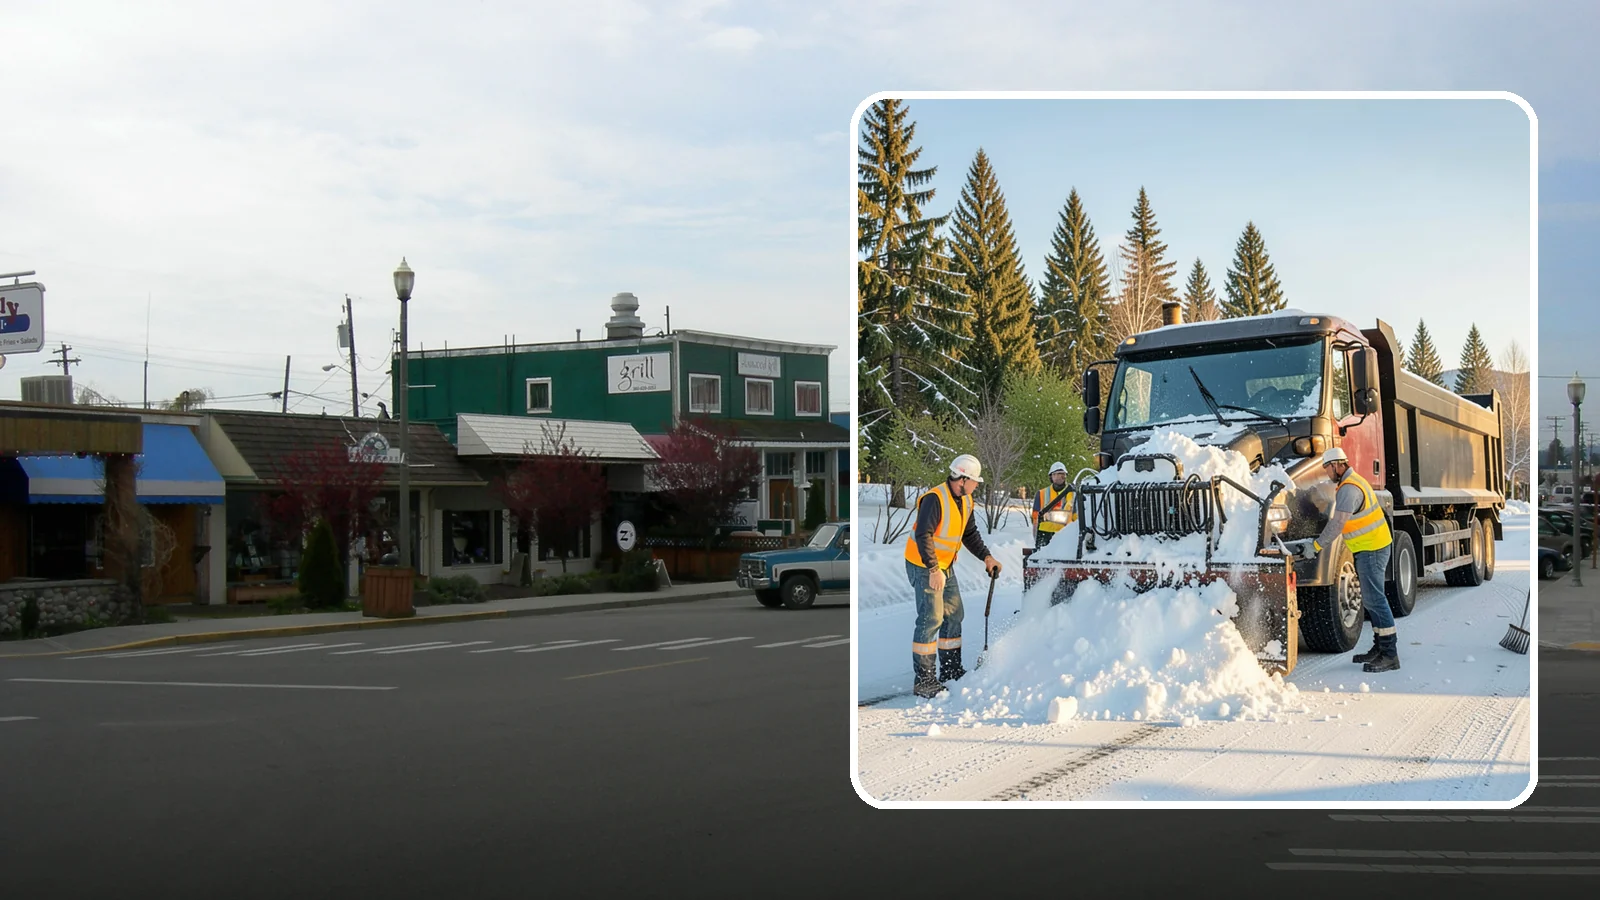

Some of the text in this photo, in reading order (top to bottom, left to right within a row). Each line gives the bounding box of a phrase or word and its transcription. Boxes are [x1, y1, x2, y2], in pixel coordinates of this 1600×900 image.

[0, 297, 19, 325] ly
[20, 337, 38, 345] Salads
[618, 356, 654, 391] grill
[620, 530, 633, 541] Z's
